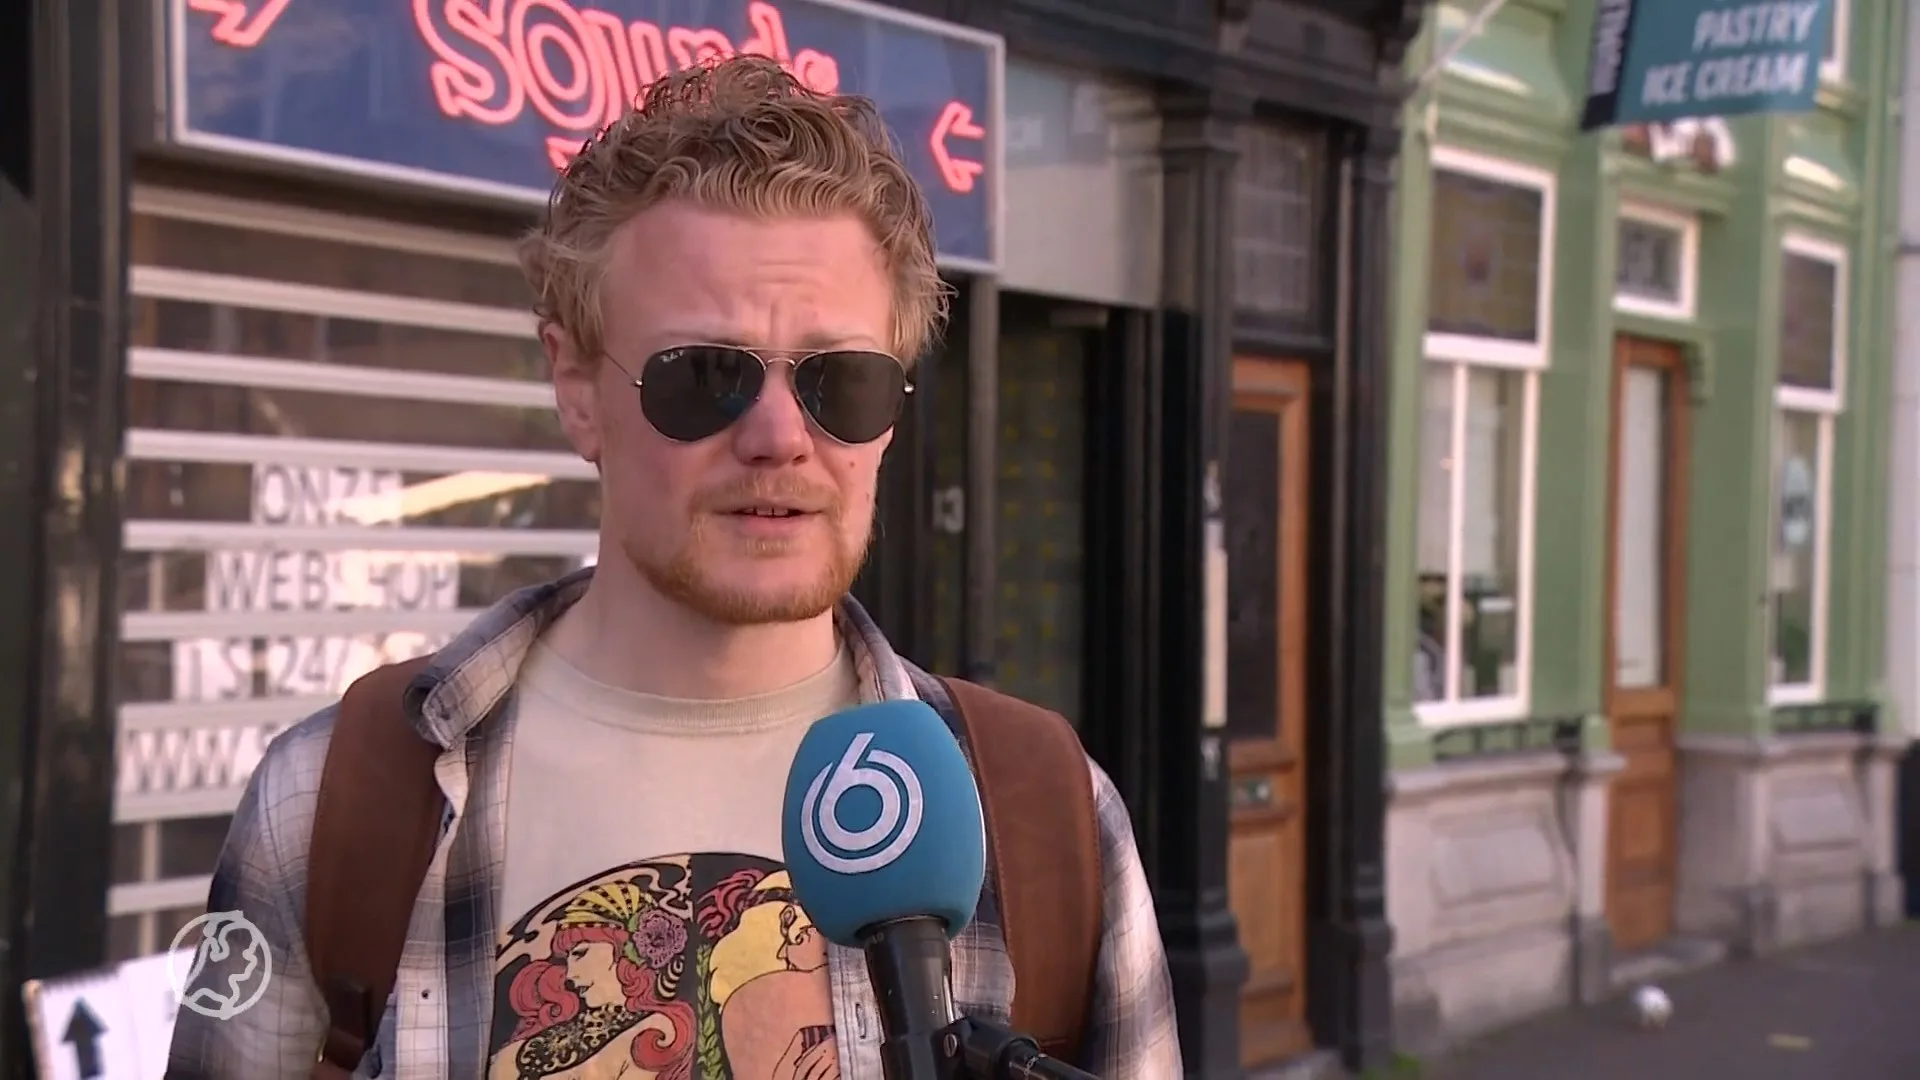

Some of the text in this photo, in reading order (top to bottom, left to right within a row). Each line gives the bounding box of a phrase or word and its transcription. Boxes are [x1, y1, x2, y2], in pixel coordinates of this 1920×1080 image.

[1692, 3, 1820, 50] PASTRY
[1643, 54, 1808, 104] ICE CREAM
[802, 732, 923, 874] 6
